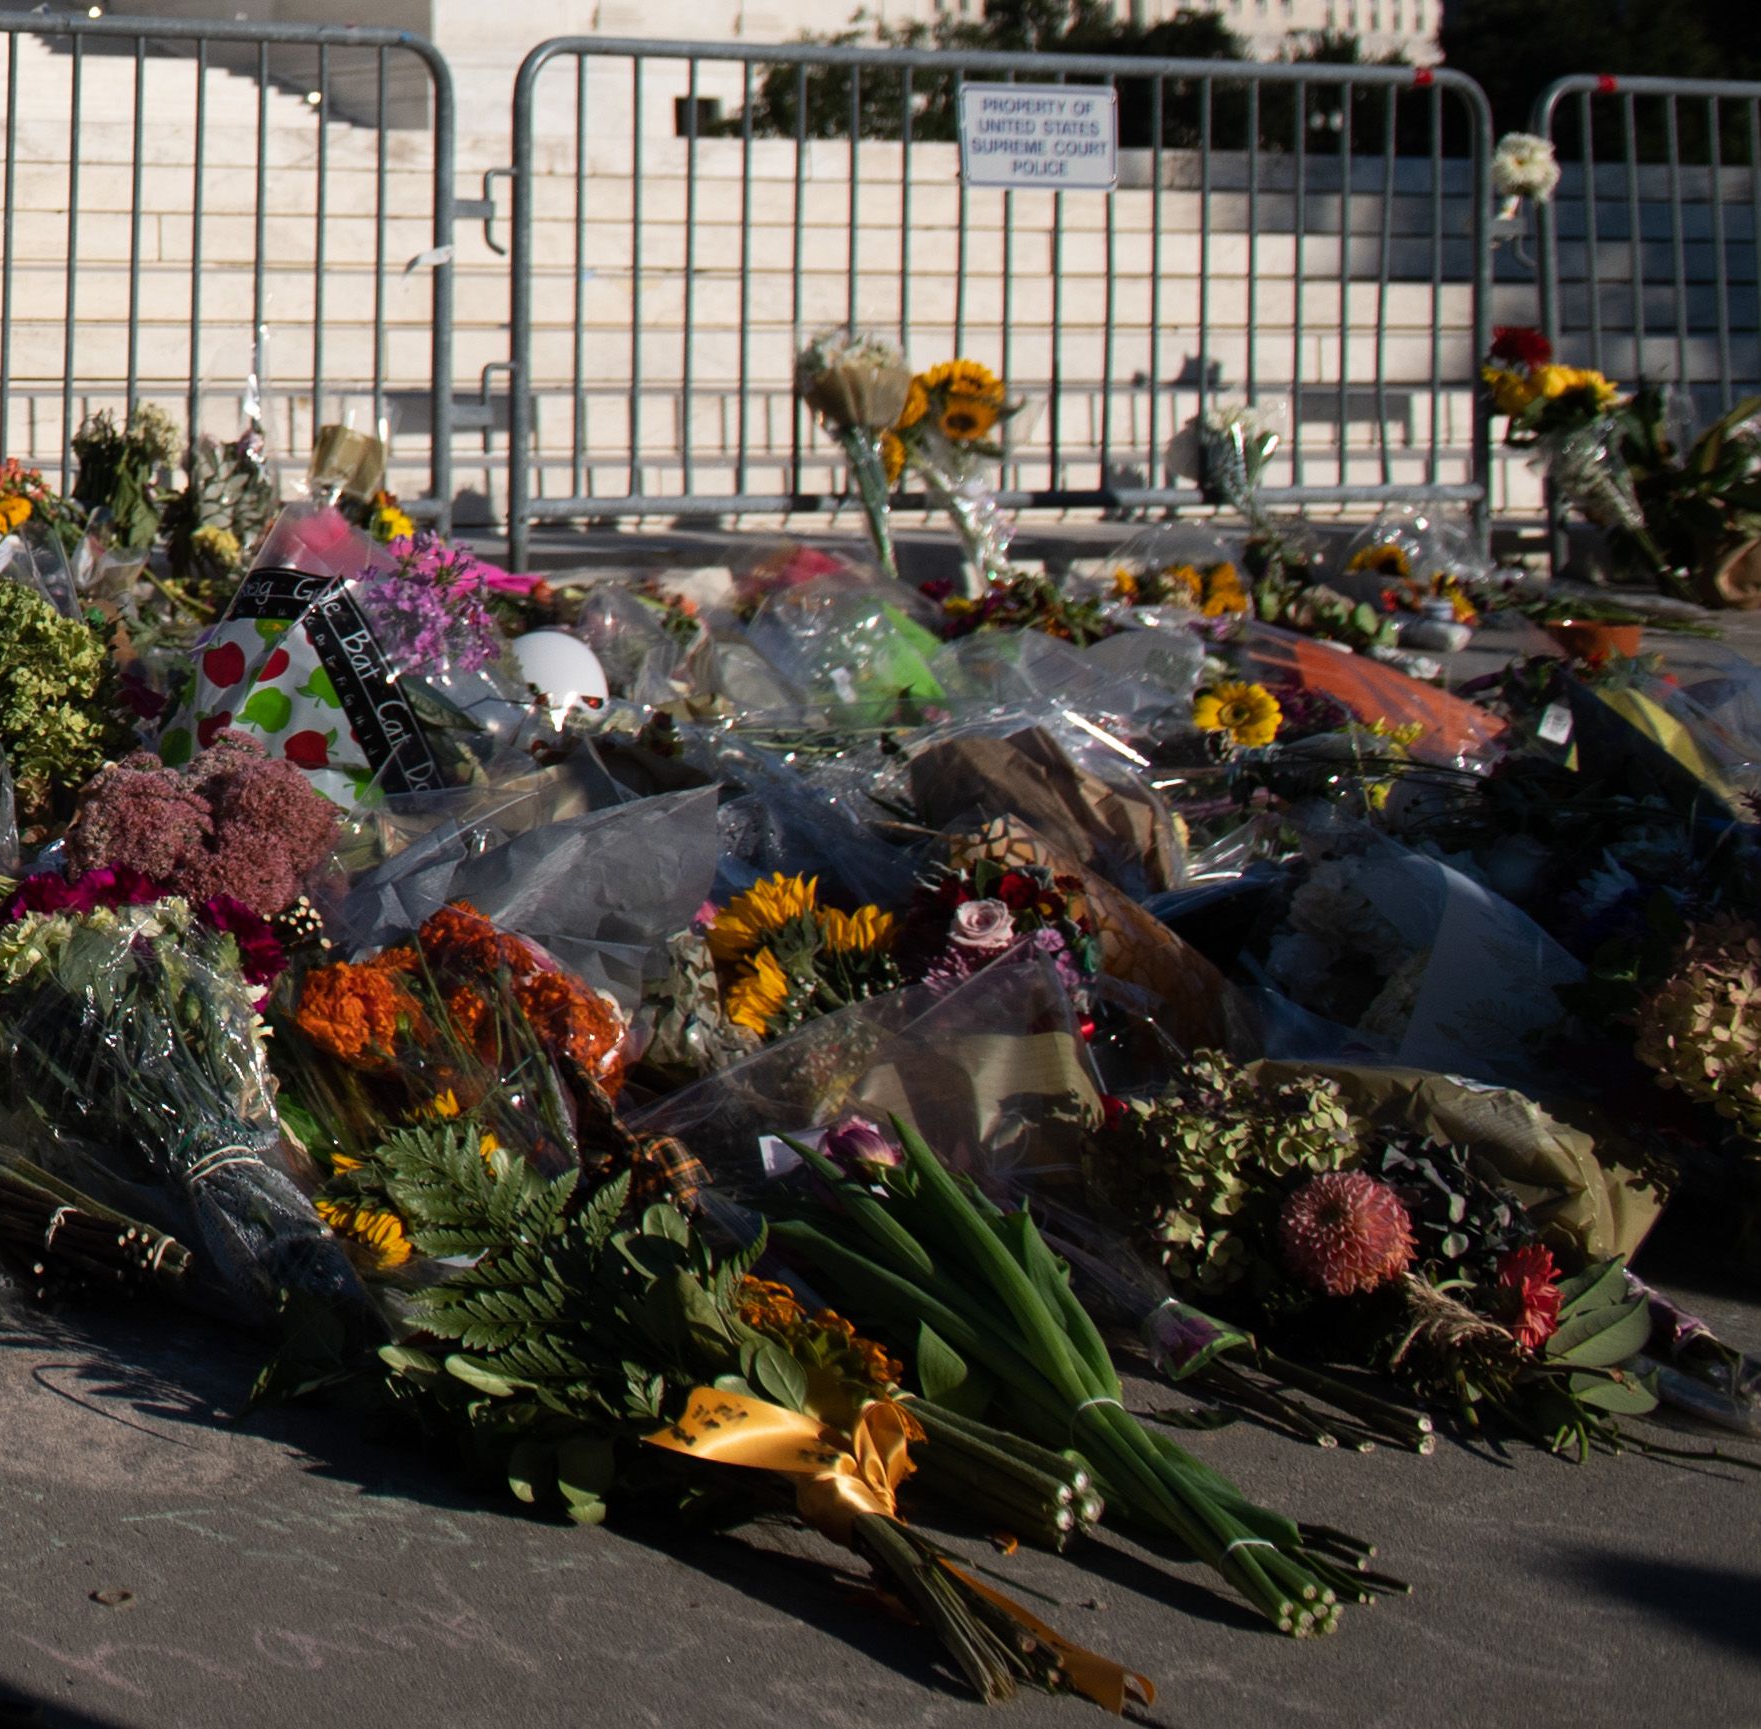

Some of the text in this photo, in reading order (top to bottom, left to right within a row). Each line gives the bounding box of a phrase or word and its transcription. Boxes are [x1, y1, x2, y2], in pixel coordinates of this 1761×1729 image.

[982, 98, 1095, 116] PROPERTY OF
[978, 119, 1100, 137] UNITED STATES
[971, 139, 1108, 157] SUPREME COURT
[1012, 159, 1068, 176] POLICE
[341, 629, 380, 680] Bat
[377, 700, 412, 746] Cat
